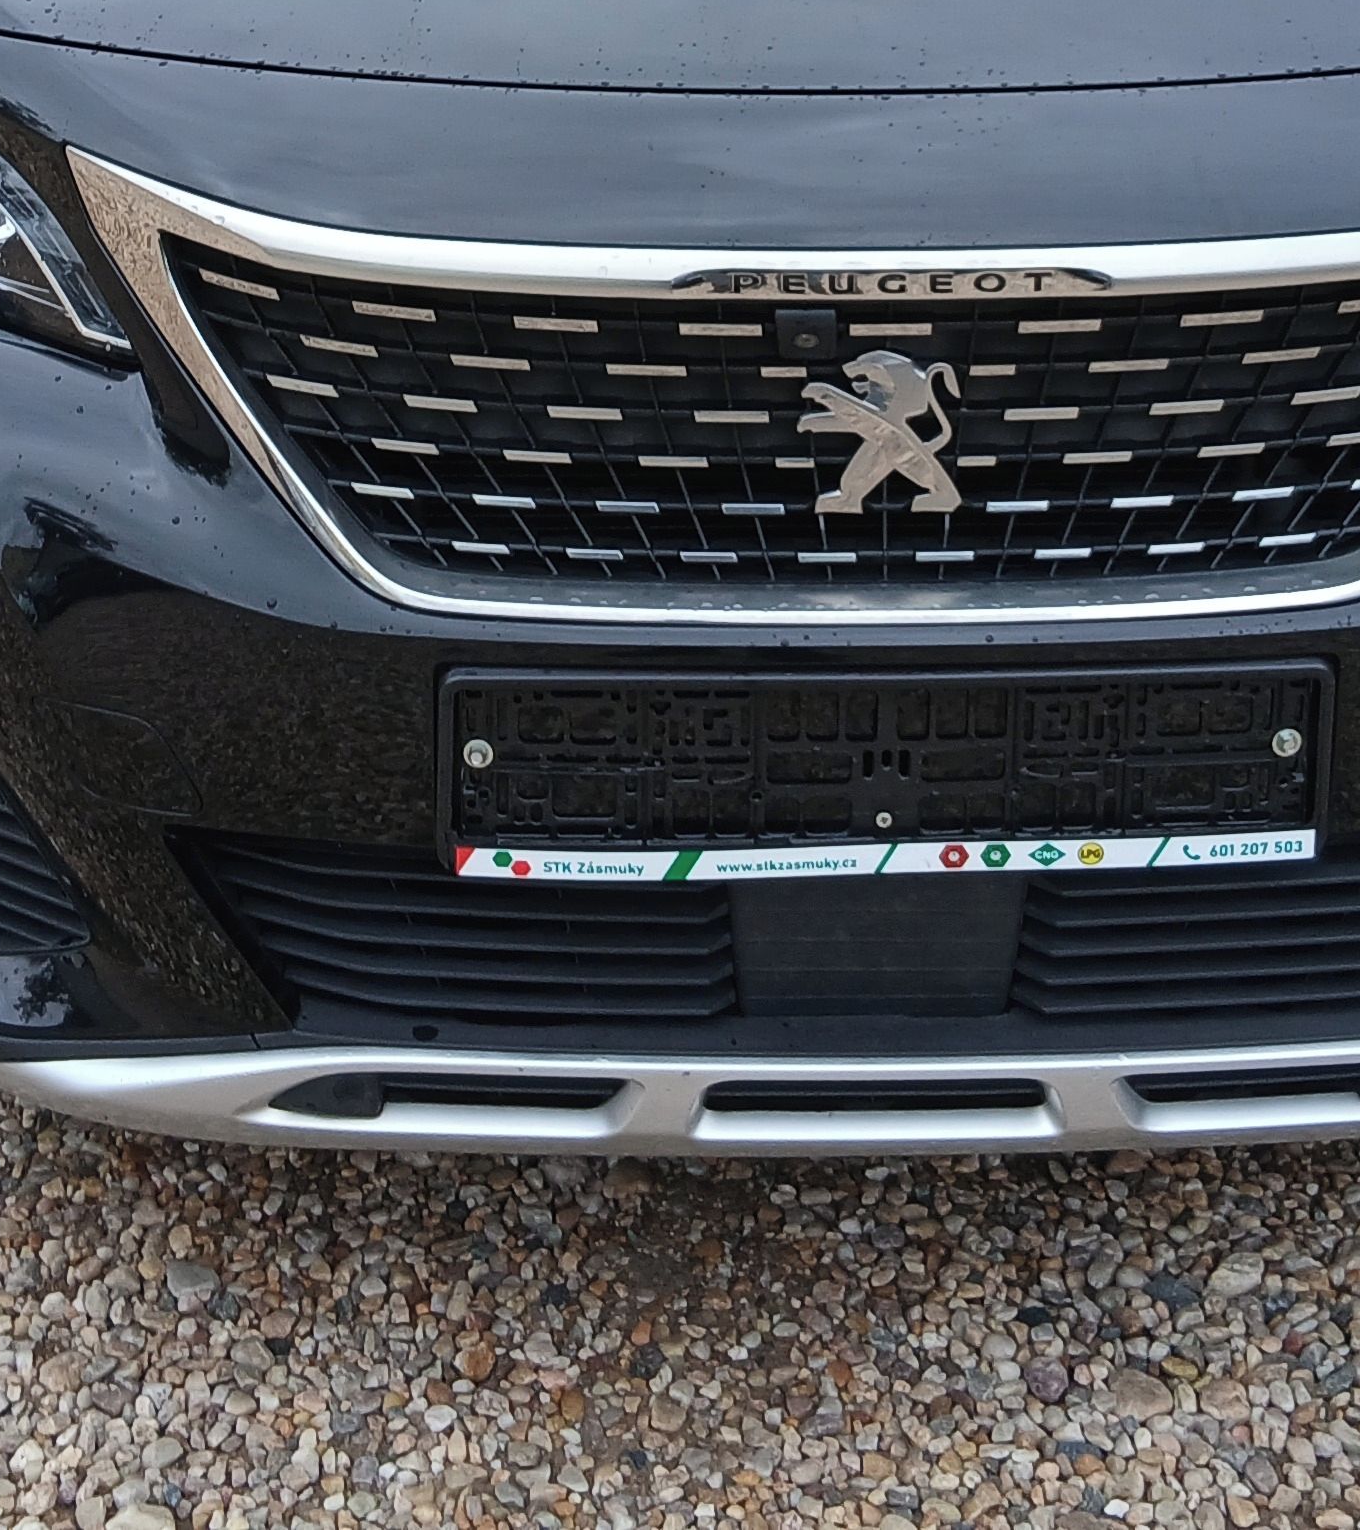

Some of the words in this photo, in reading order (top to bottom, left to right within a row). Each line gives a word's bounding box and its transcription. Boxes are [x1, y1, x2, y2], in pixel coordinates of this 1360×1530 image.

[731, 271, 1053, 295] PEUGEOT
[1080, 848, 1101, 859] LPG
[1209, 844, 1235, 858] 601
[1240, 842, 1269, 856] 207
[1274, 840, 1304, 854] 503
[543, 861, 572, 874] STK
[578, 861, 644, 876] Zásmuky
[716, 856, 858, 873] www.stkzasmuky.cz
